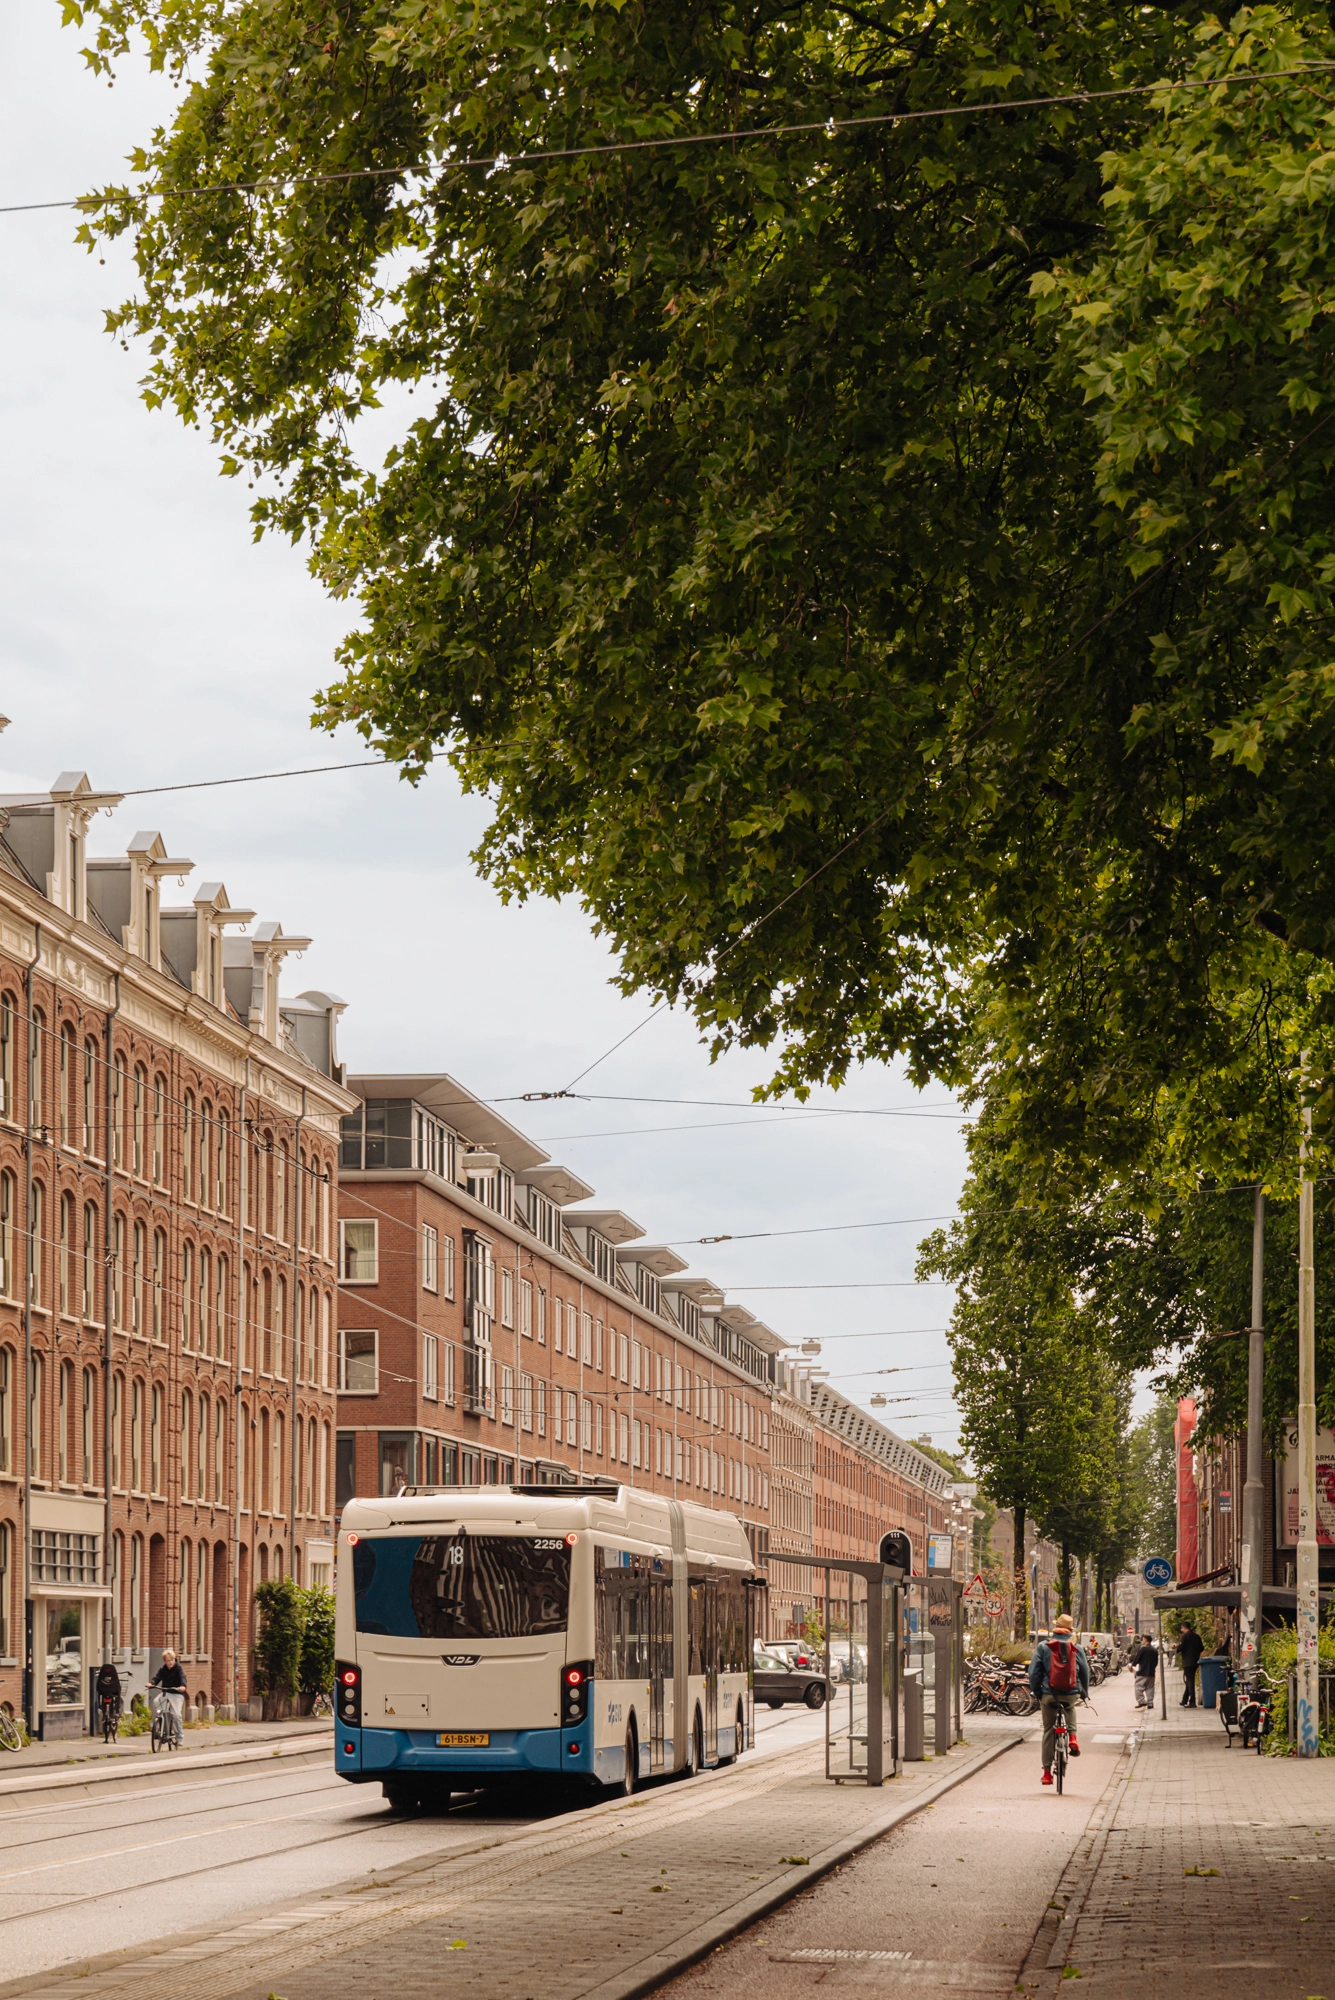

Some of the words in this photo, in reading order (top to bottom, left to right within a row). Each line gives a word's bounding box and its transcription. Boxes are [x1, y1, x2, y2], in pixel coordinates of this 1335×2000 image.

[534, 1539, 563, 1550] 2256
[449, 1546, 464, 1565] 18
[987, 1601, 1002, 1609] 30
[446, 1656, 474, 1664] VDL
[444, 1734, 485, 1744] 61-BSN-7
